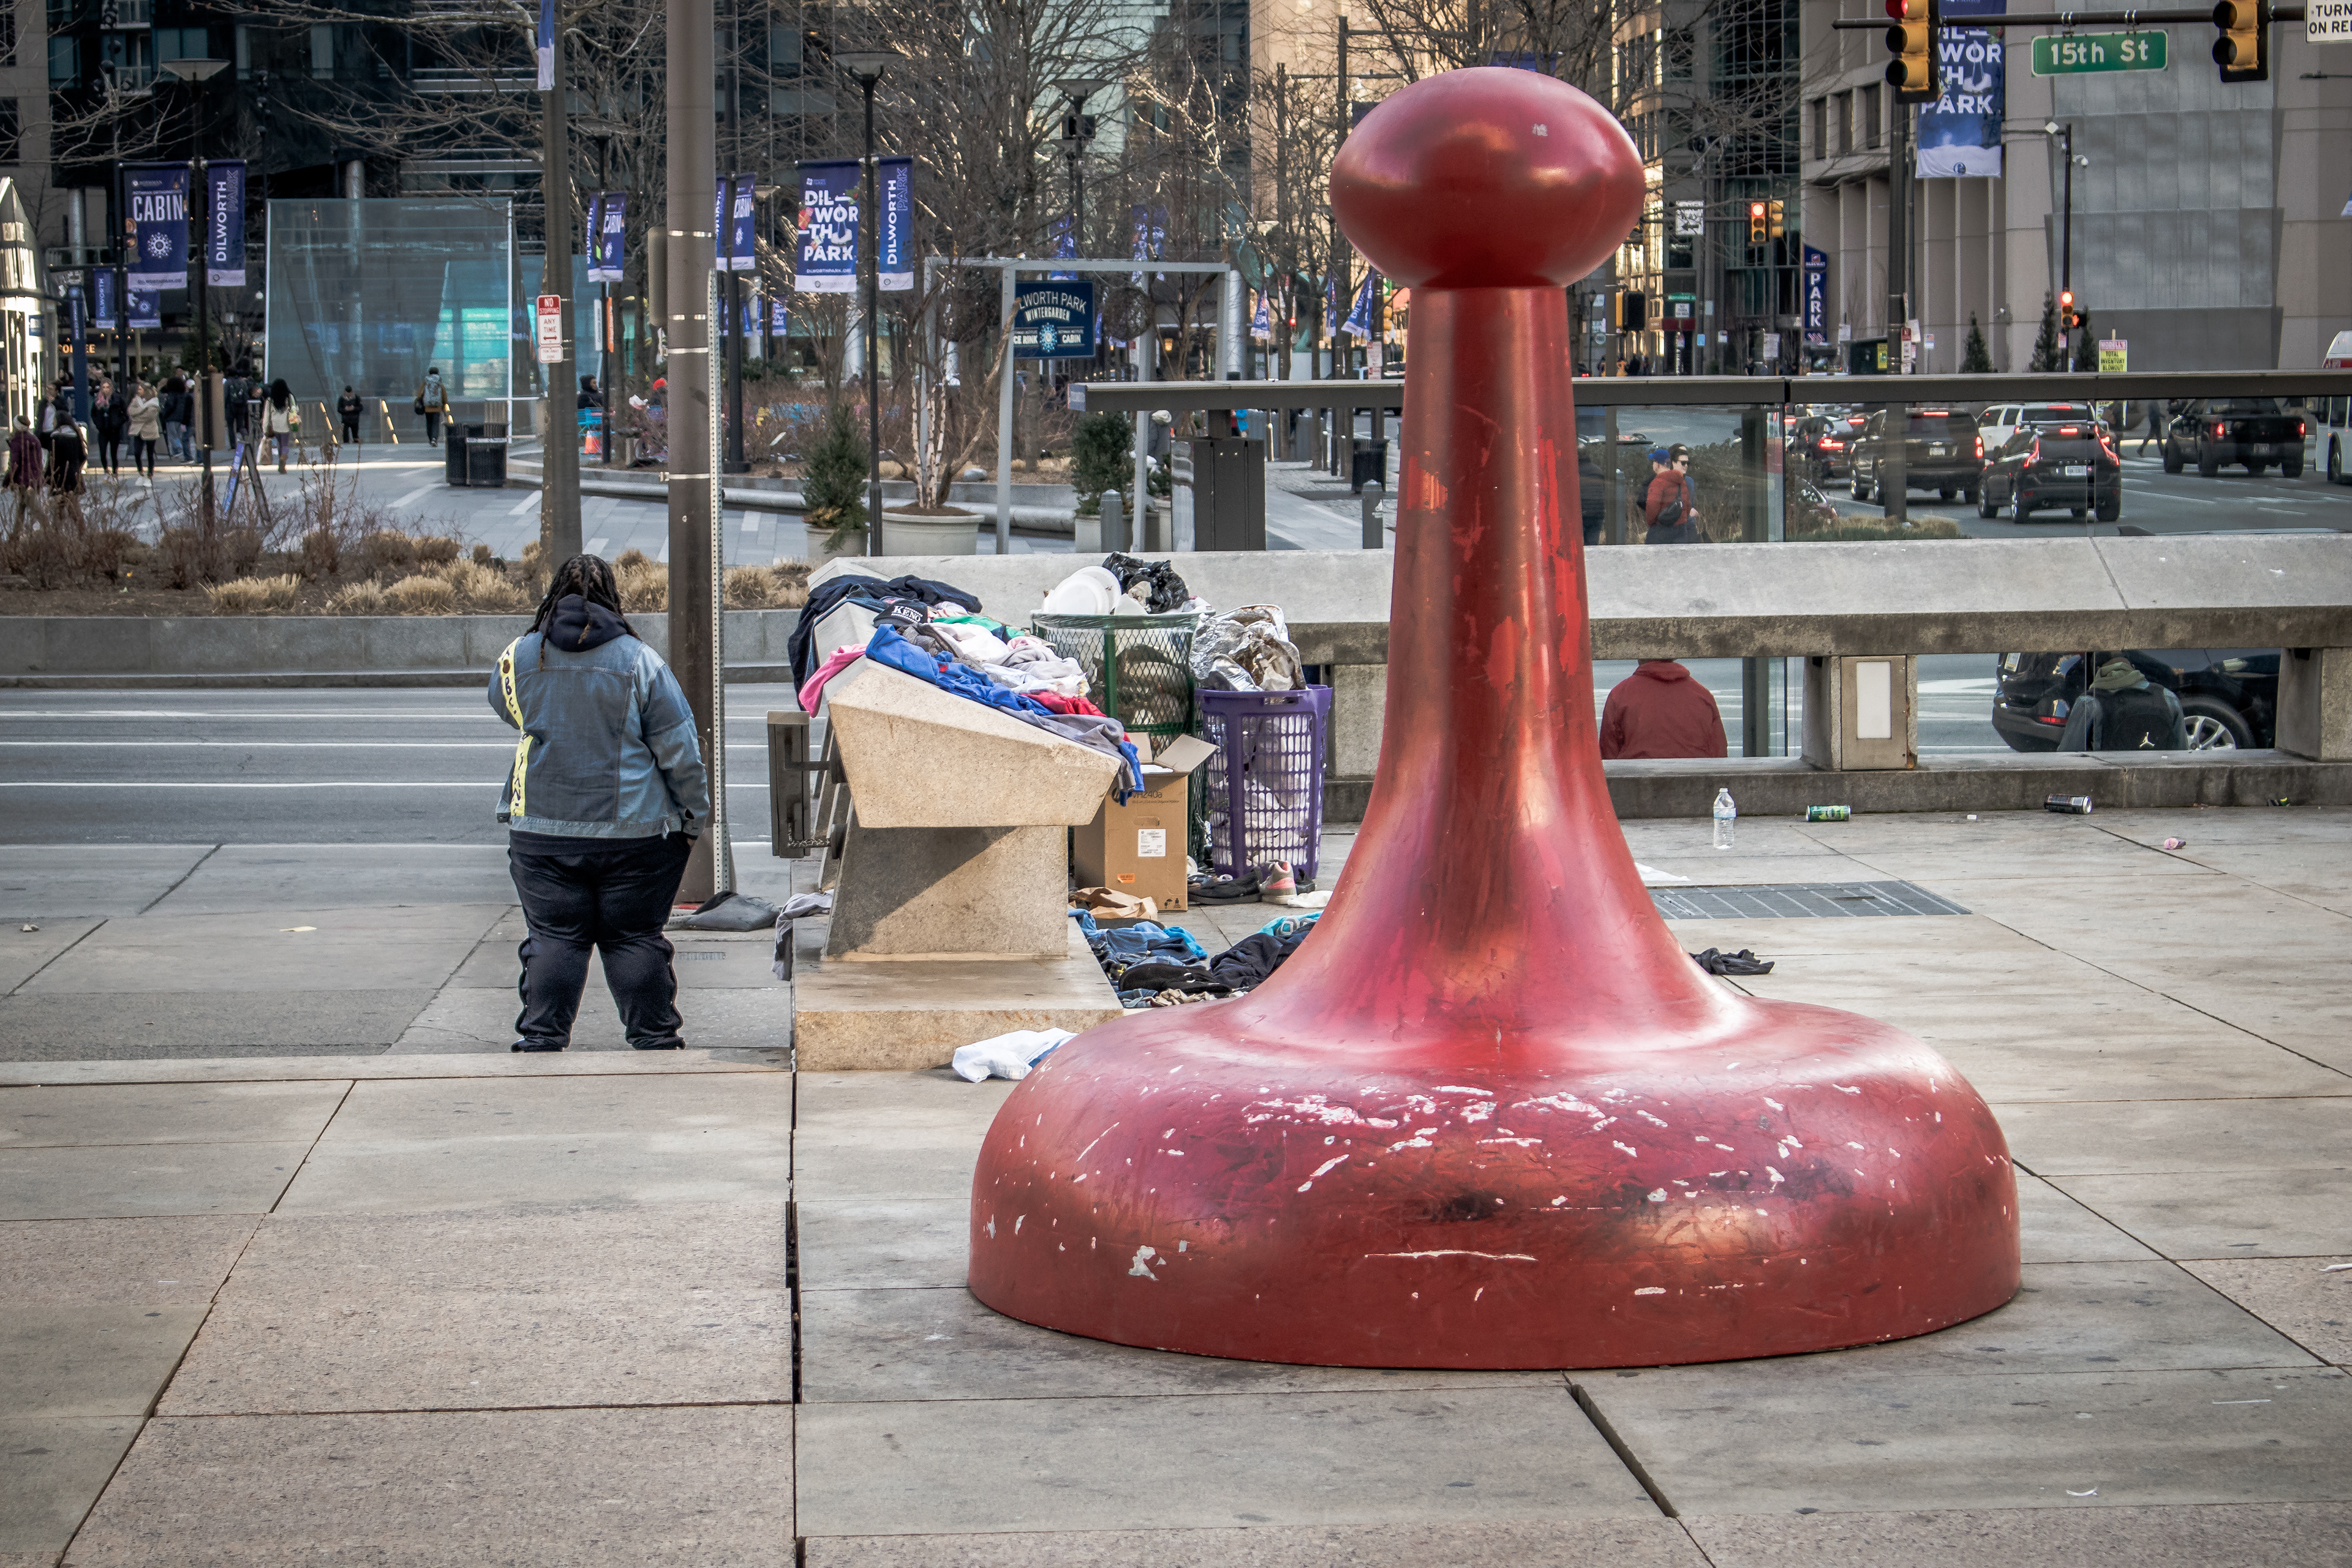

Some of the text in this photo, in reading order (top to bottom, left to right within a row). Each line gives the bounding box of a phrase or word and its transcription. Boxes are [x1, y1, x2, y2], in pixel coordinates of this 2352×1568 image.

[2316, 3, 2352, 17] TURN
[2309, 21, 2327, 34] ON
[1939, 43, 2002, 63] WOR
[2051, 39, 2149, 66] 15th St
[1940, 66, 1964, 85] H
[1921, 94, 1994, 115] PARK
[227, 169, 239, 212] PARK
[897, 167, 908, 211] PARK
[133, 194, 183, 222] CABIN
[814, 205, 859, 223] WOR
[216, 181, 227, 262] DILWORTH
[887, 179, 897, 265] DILWORTH
[804, 245, 854, 262] PARK
[544, 297, 554, 307] NO
[1019, 291, 1087, 314] LWORTH PARK
[1810, 272, 1822, 327] PARK
[1025, 306, 1071, 322] WINTERGARDEN
[58, 344, 96, 353] OEE
[1022, 335, 1038, 344] RINK
[1062, 334, 1082, 344] CABIN
[892, 605, 921, 622] KENO
